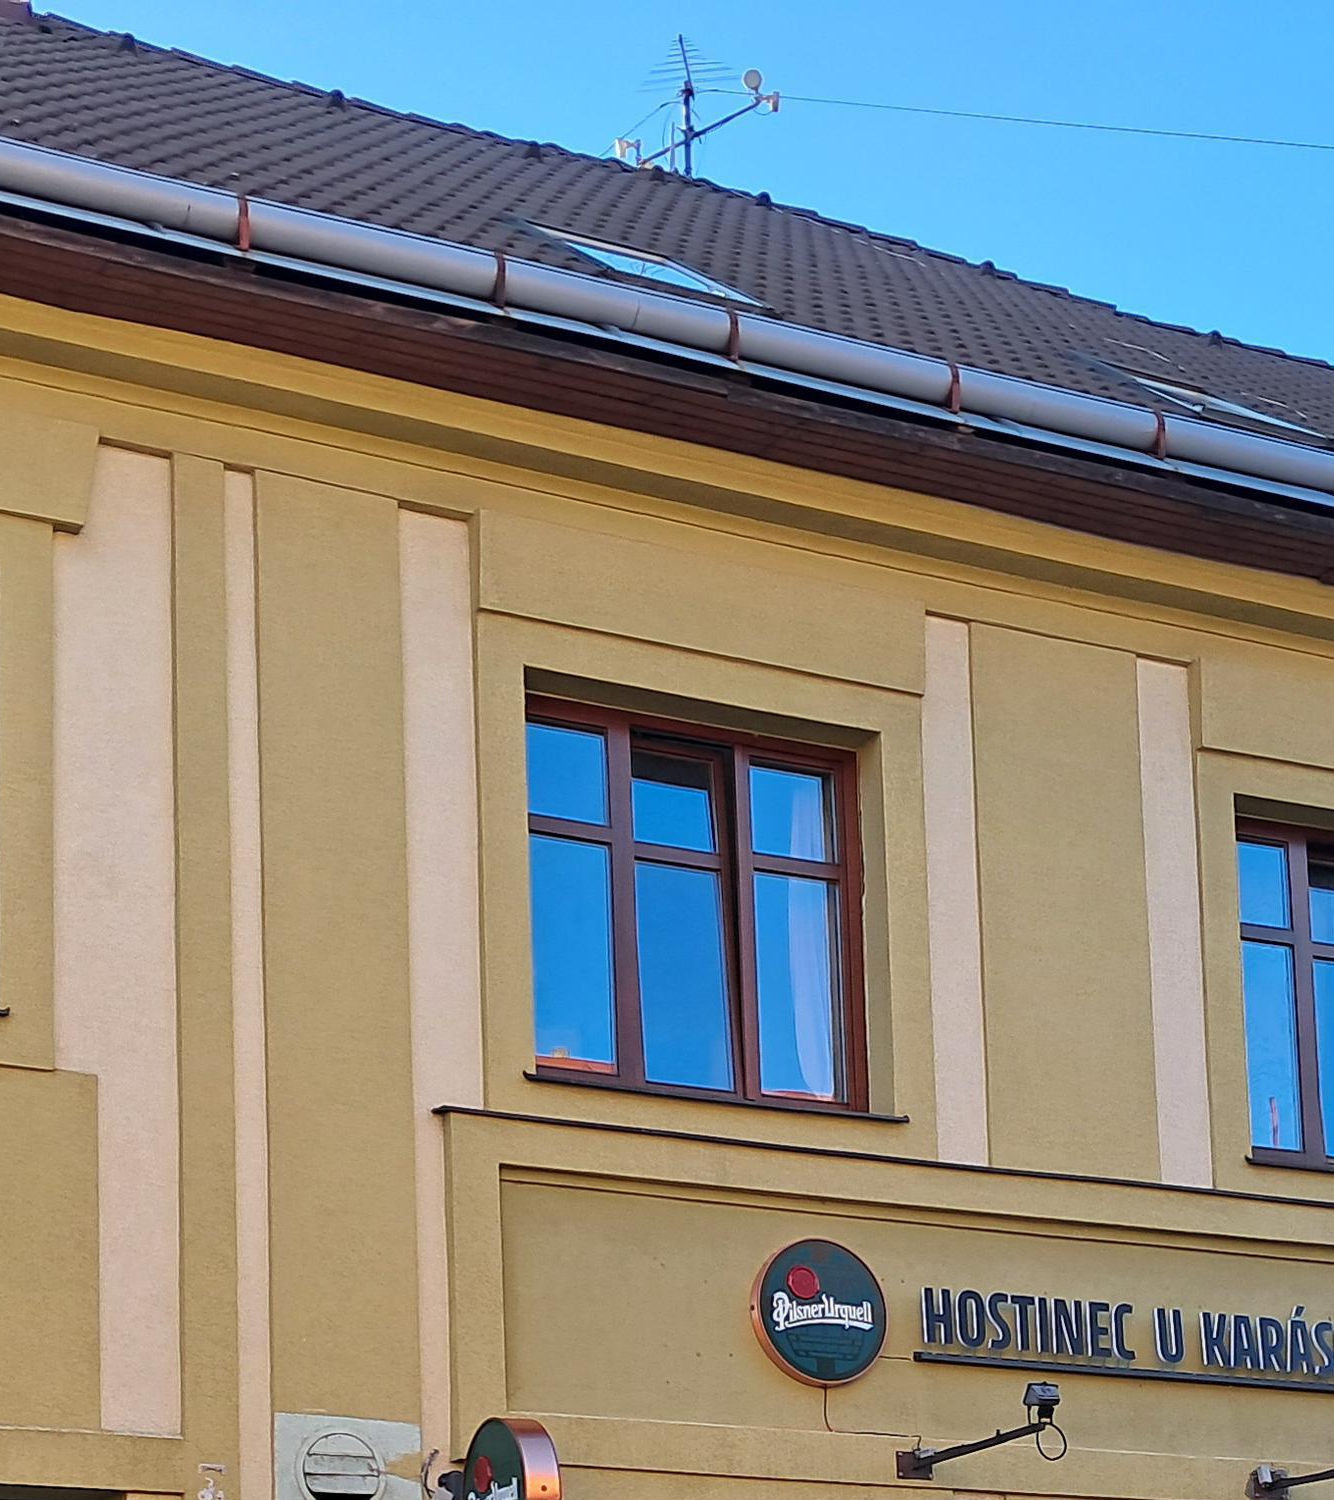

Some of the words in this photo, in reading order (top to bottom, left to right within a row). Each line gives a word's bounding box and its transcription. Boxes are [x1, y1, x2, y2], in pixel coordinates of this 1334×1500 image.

[773, 1291, 823, 1331] Pilsner
[822, 1293, 873, 1329] Urquell
[921, 1287, 1136, 1361] HOSTINEC
[1153, 1307, 1185, 1364] U
